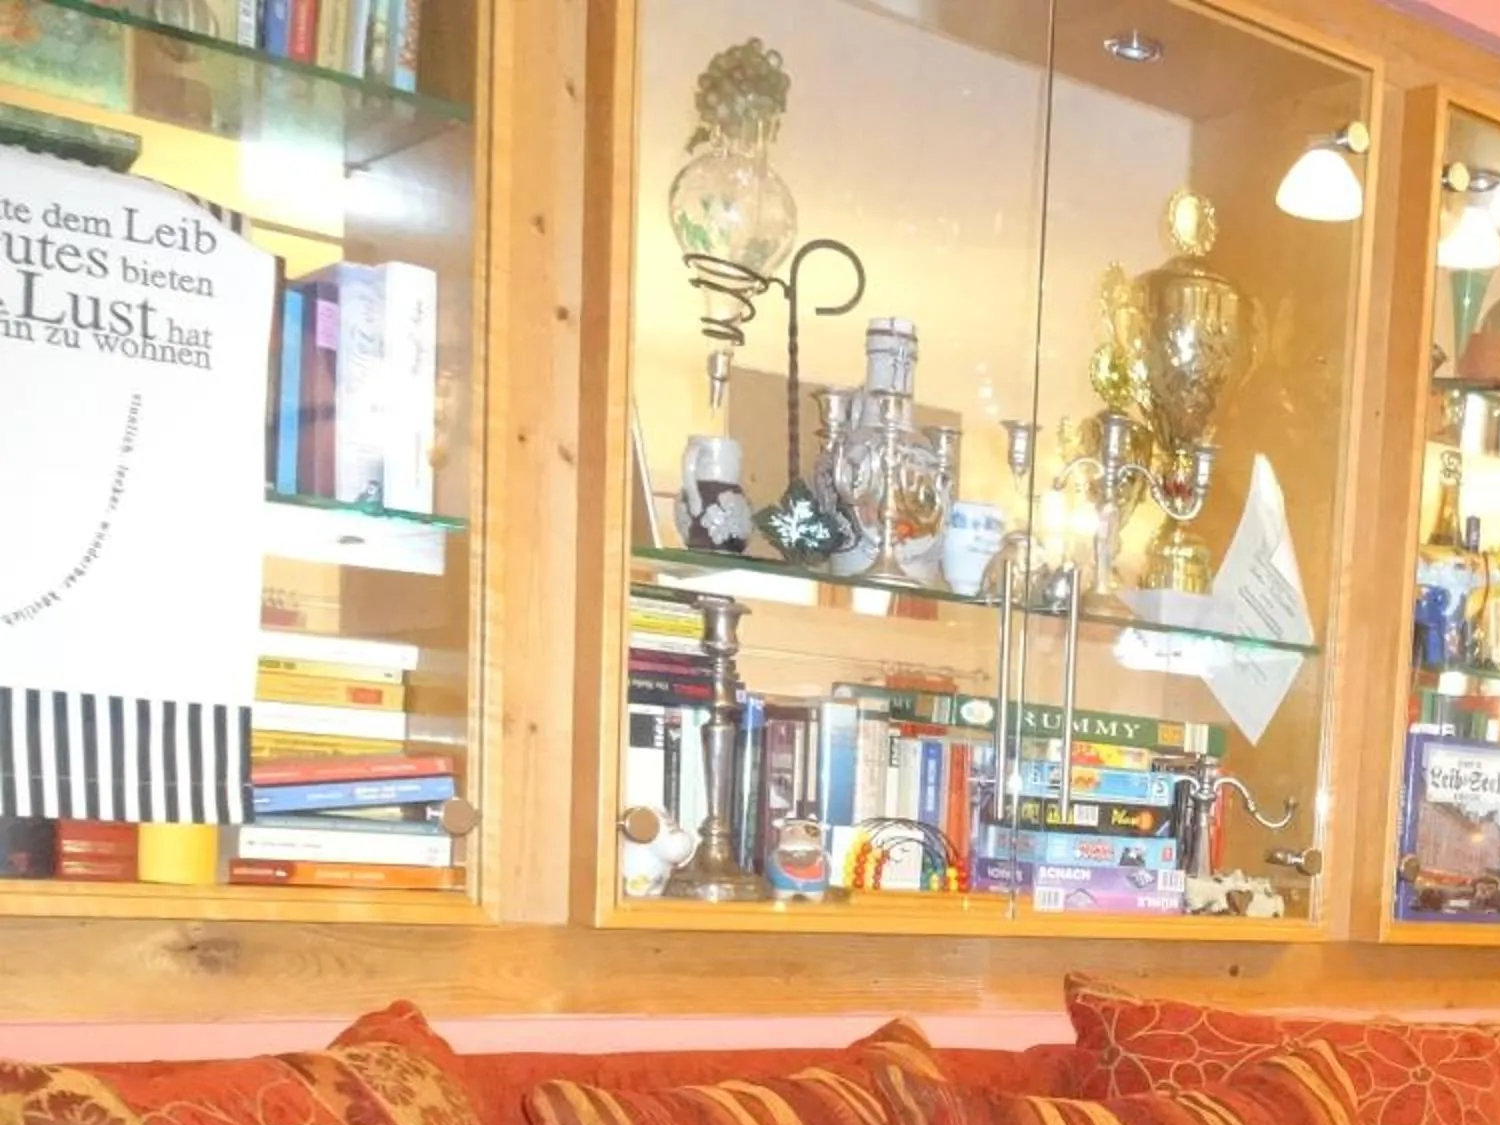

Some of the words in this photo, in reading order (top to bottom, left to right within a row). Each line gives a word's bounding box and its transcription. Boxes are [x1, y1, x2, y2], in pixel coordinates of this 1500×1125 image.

[0, 198, 32, 224] te
[41, 202, 112, 238] dem
[122, 206, 217, 255] Leib
[0, 231, 109, 278] utes
[120, 256, 214, 297] bieten
[16, 268, 157, 340] Lust
[166, 317, 213, 350] hat
[0, 316, 35, 342] in
[45, 325, 81, 349] zu
[93, 333, 212, 370] wohnen
